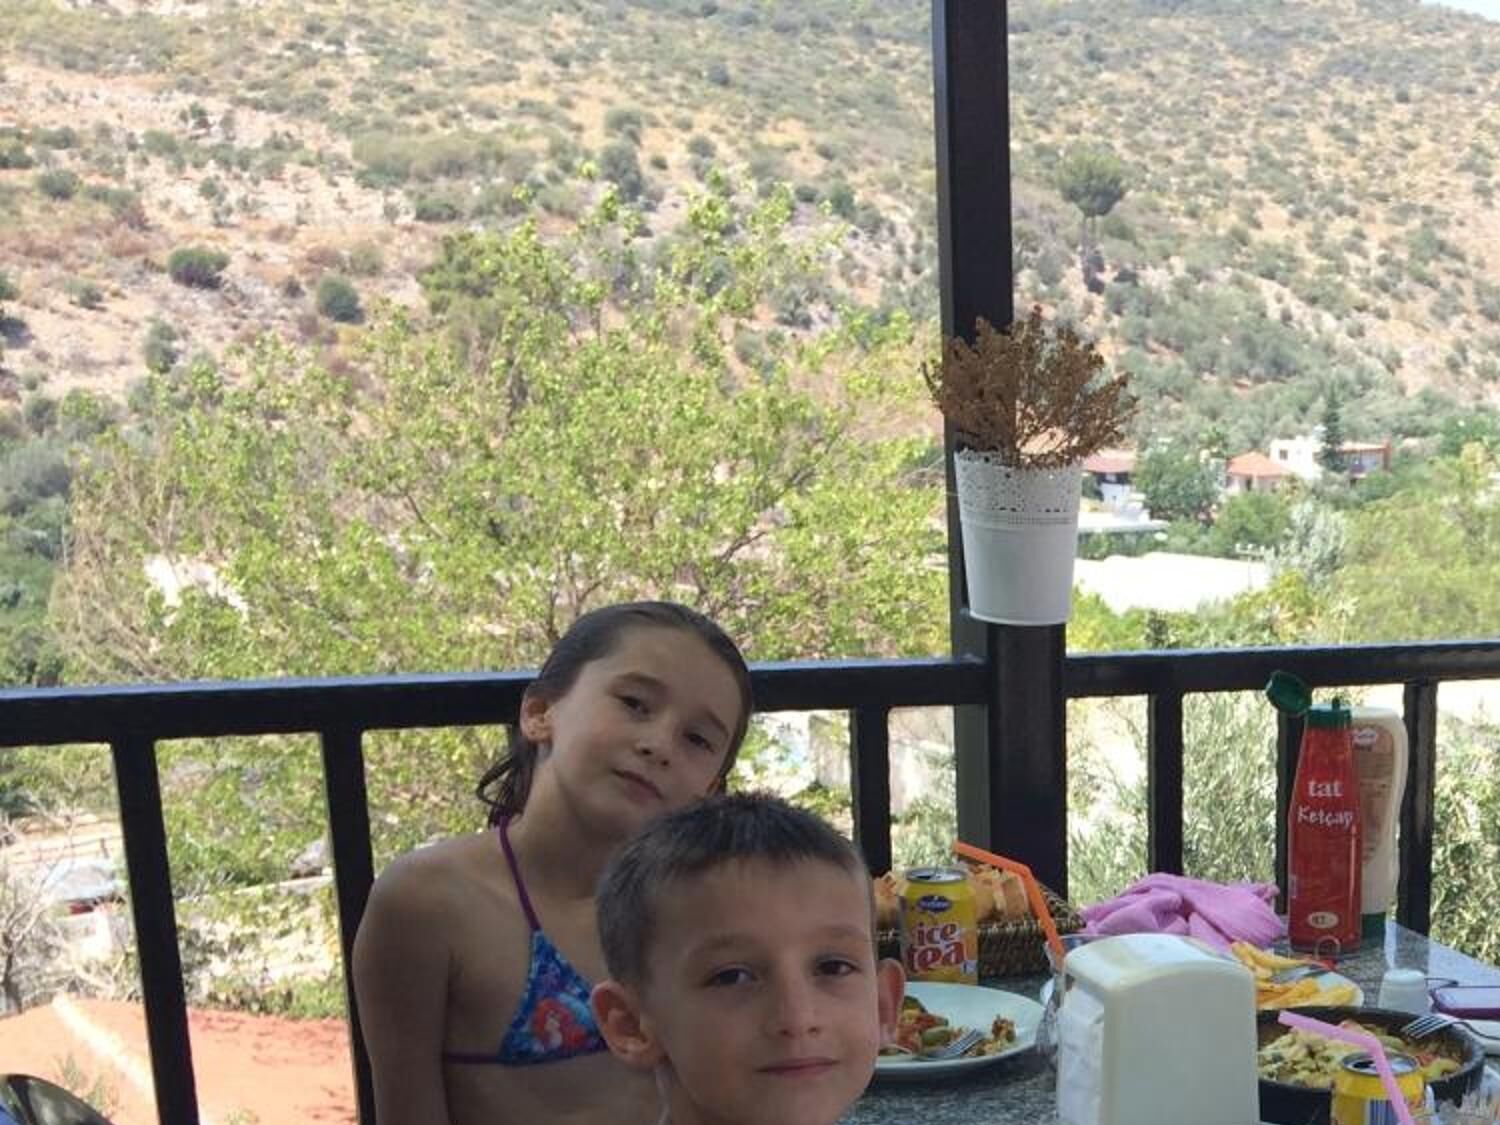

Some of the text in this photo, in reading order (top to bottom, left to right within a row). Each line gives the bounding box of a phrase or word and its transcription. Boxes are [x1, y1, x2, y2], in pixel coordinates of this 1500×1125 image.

[1308, 779, 1344, 798] tat
[916, 921, 959, 946] ice
[906, 942, 966, 973] tea
